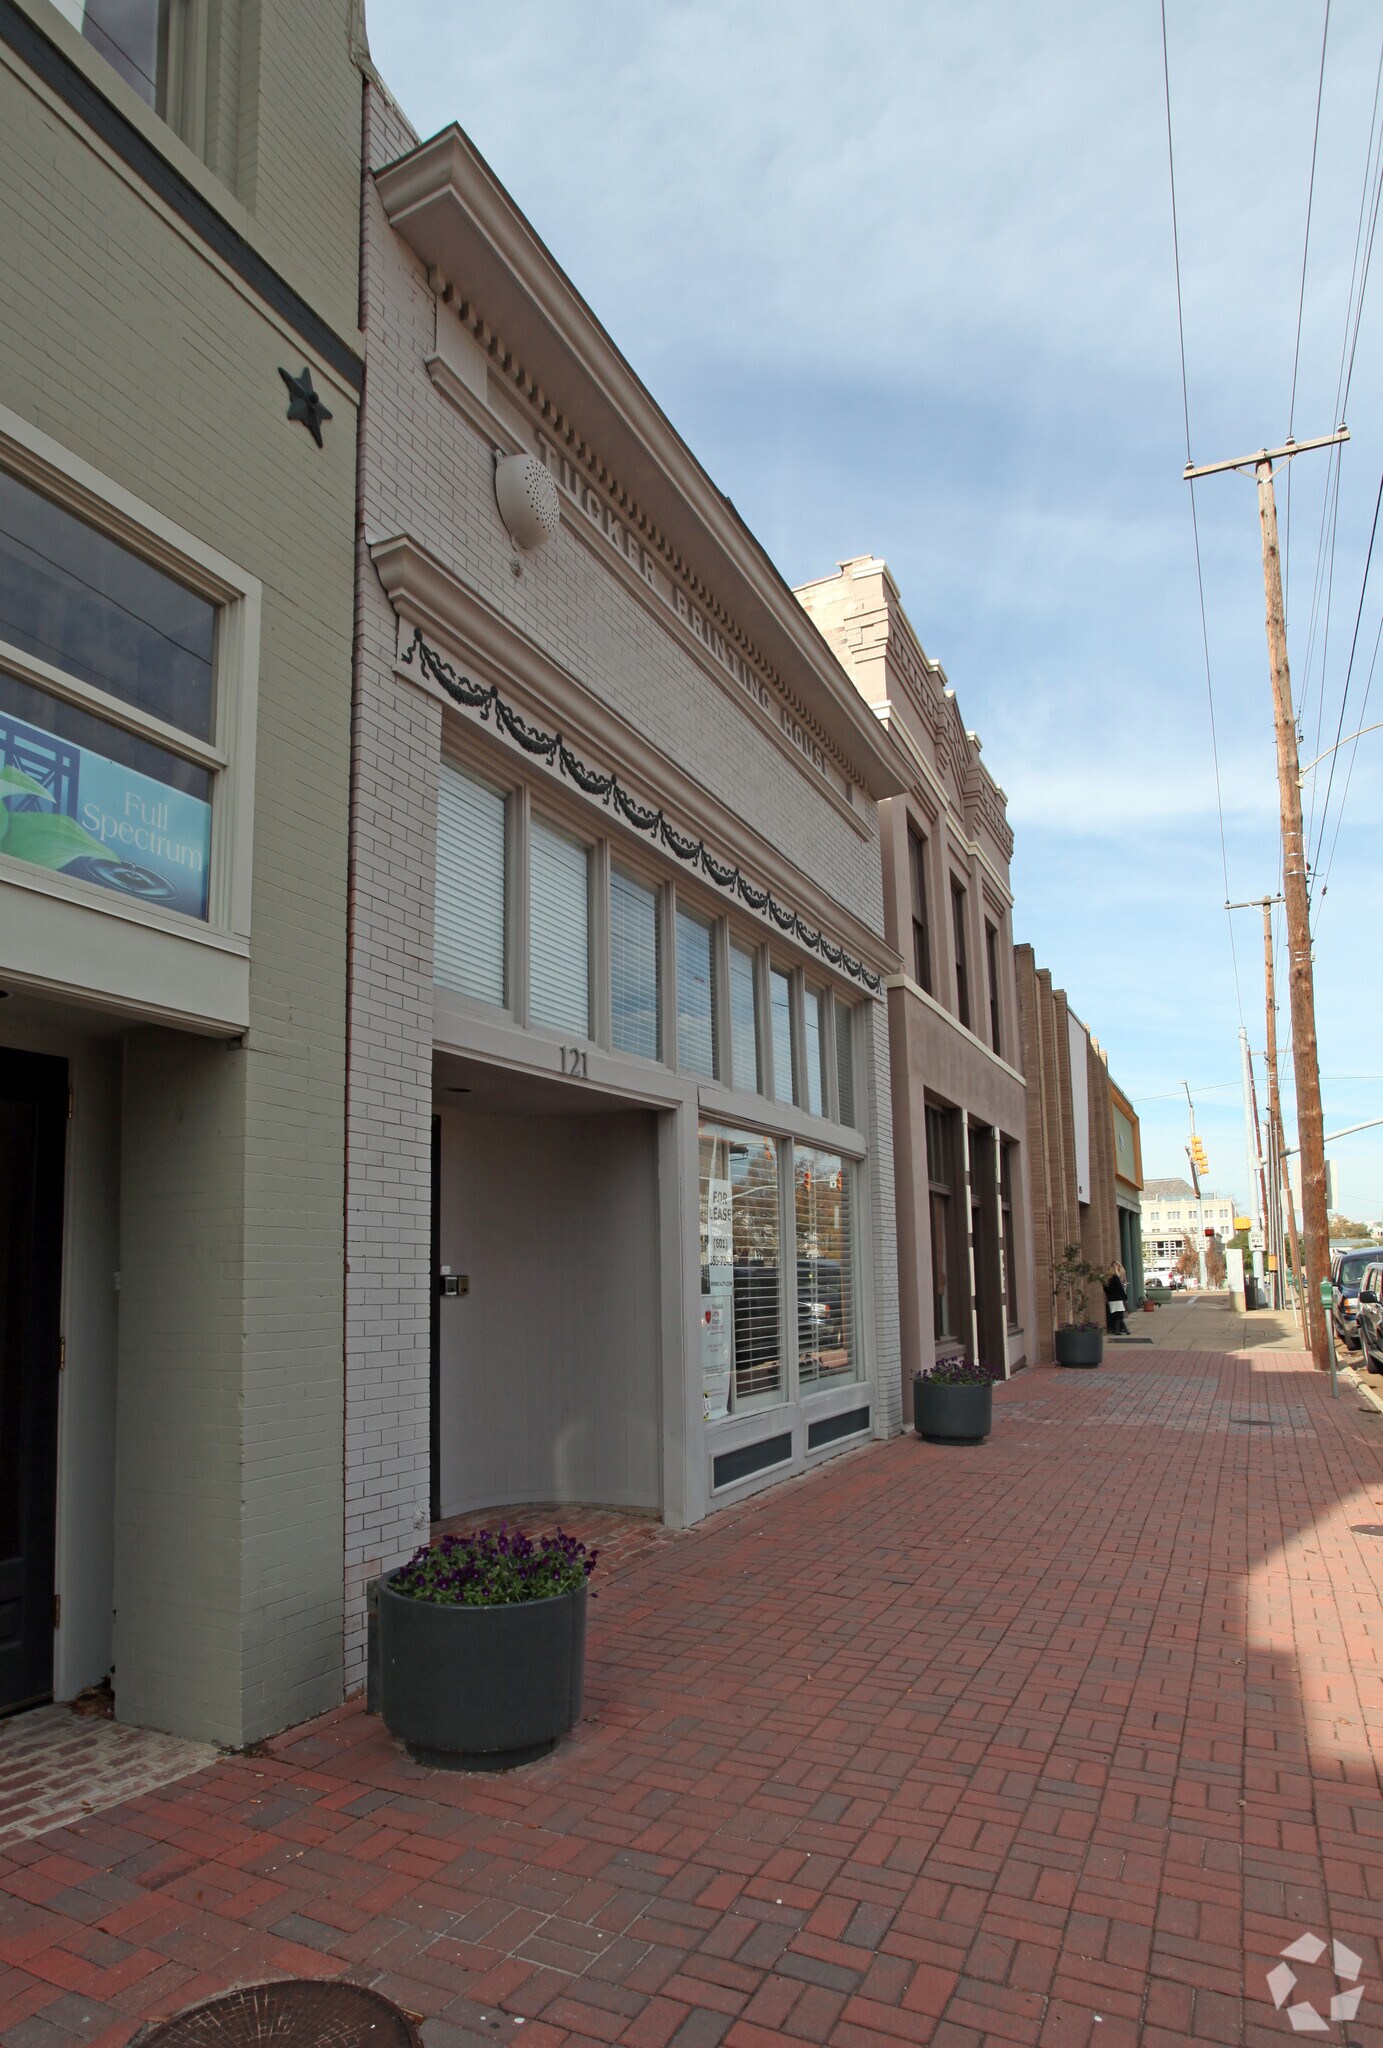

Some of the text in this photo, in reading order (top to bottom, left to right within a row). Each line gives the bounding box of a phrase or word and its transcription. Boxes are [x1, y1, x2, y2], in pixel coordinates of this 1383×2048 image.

[537, 431, 657, 584] TUCKER
[675, 587, 769, 708] PRINTING
[124, 790, 168, 831] Full
[82, 803, 202, 871] Spectrum
[560, 1045, 588, 1079] 121
[709, 1206, 732, 1221] LEASE
[713, 1191, 728, 1205] FOR
[713, 1238, 728, 1251] (601)
